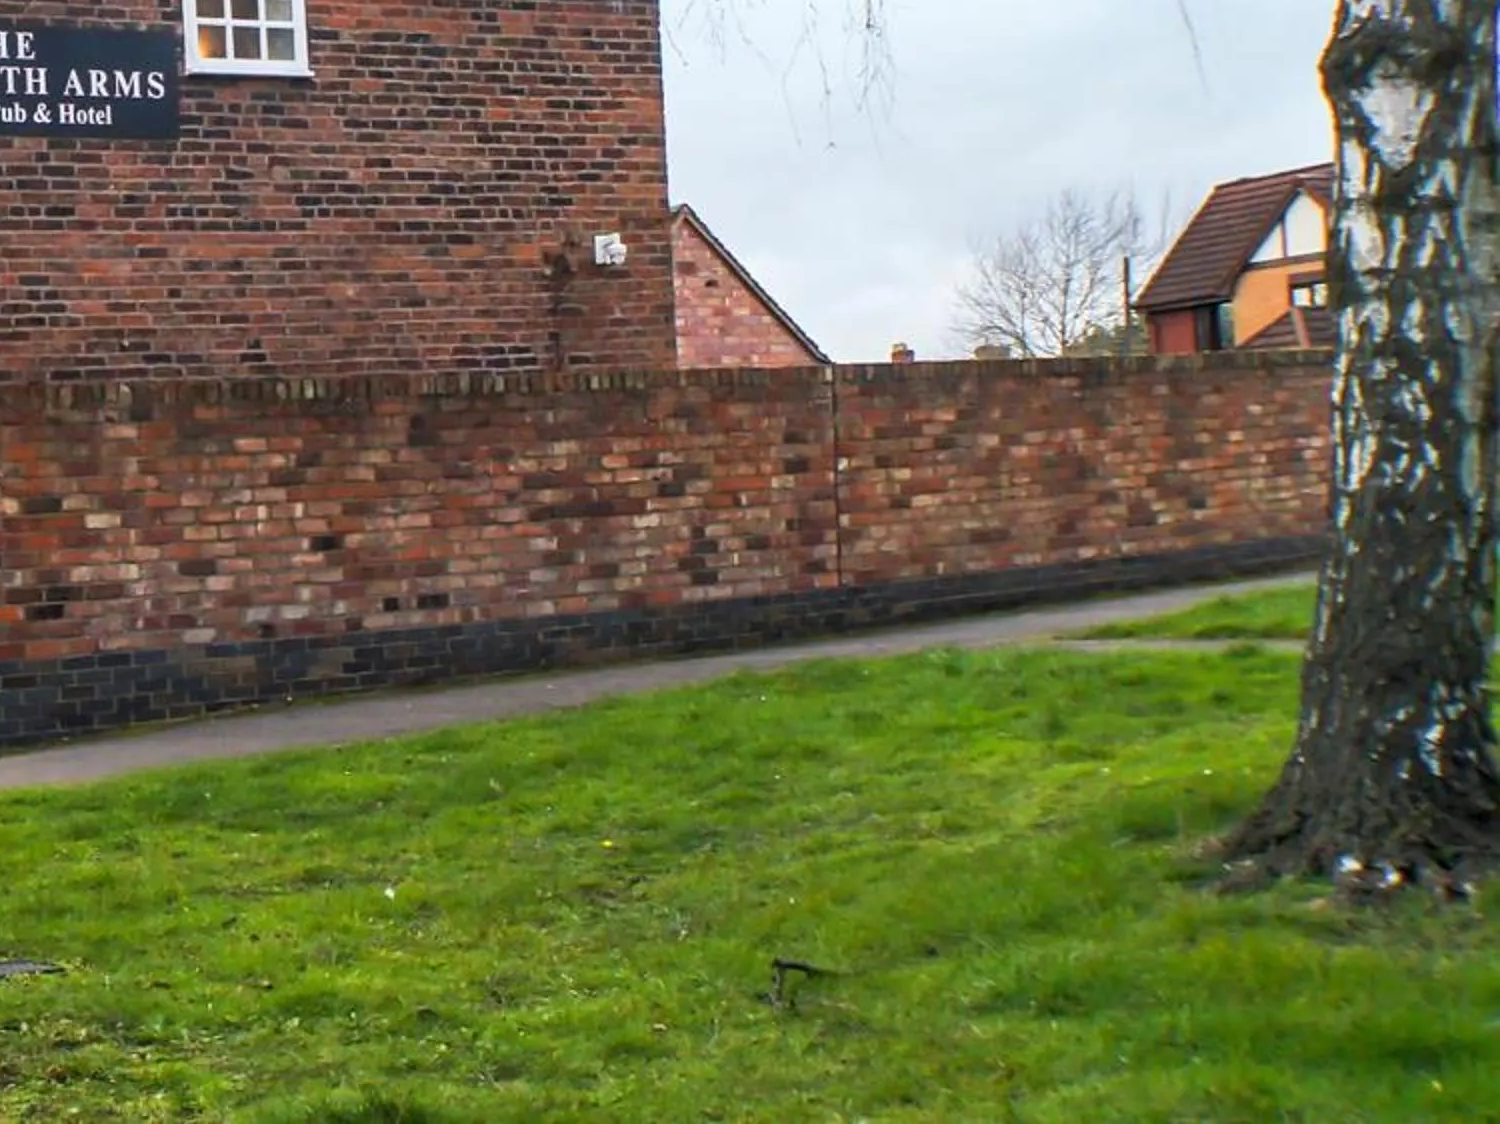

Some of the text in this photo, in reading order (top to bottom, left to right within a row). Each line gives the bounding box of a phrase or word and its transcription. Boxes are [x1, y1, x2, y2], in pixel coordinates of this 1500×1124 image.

[63, 70, 166, 99] ARMS
[34, 105, 52, 124] &
[58, 104, 113, 126] Hotel
